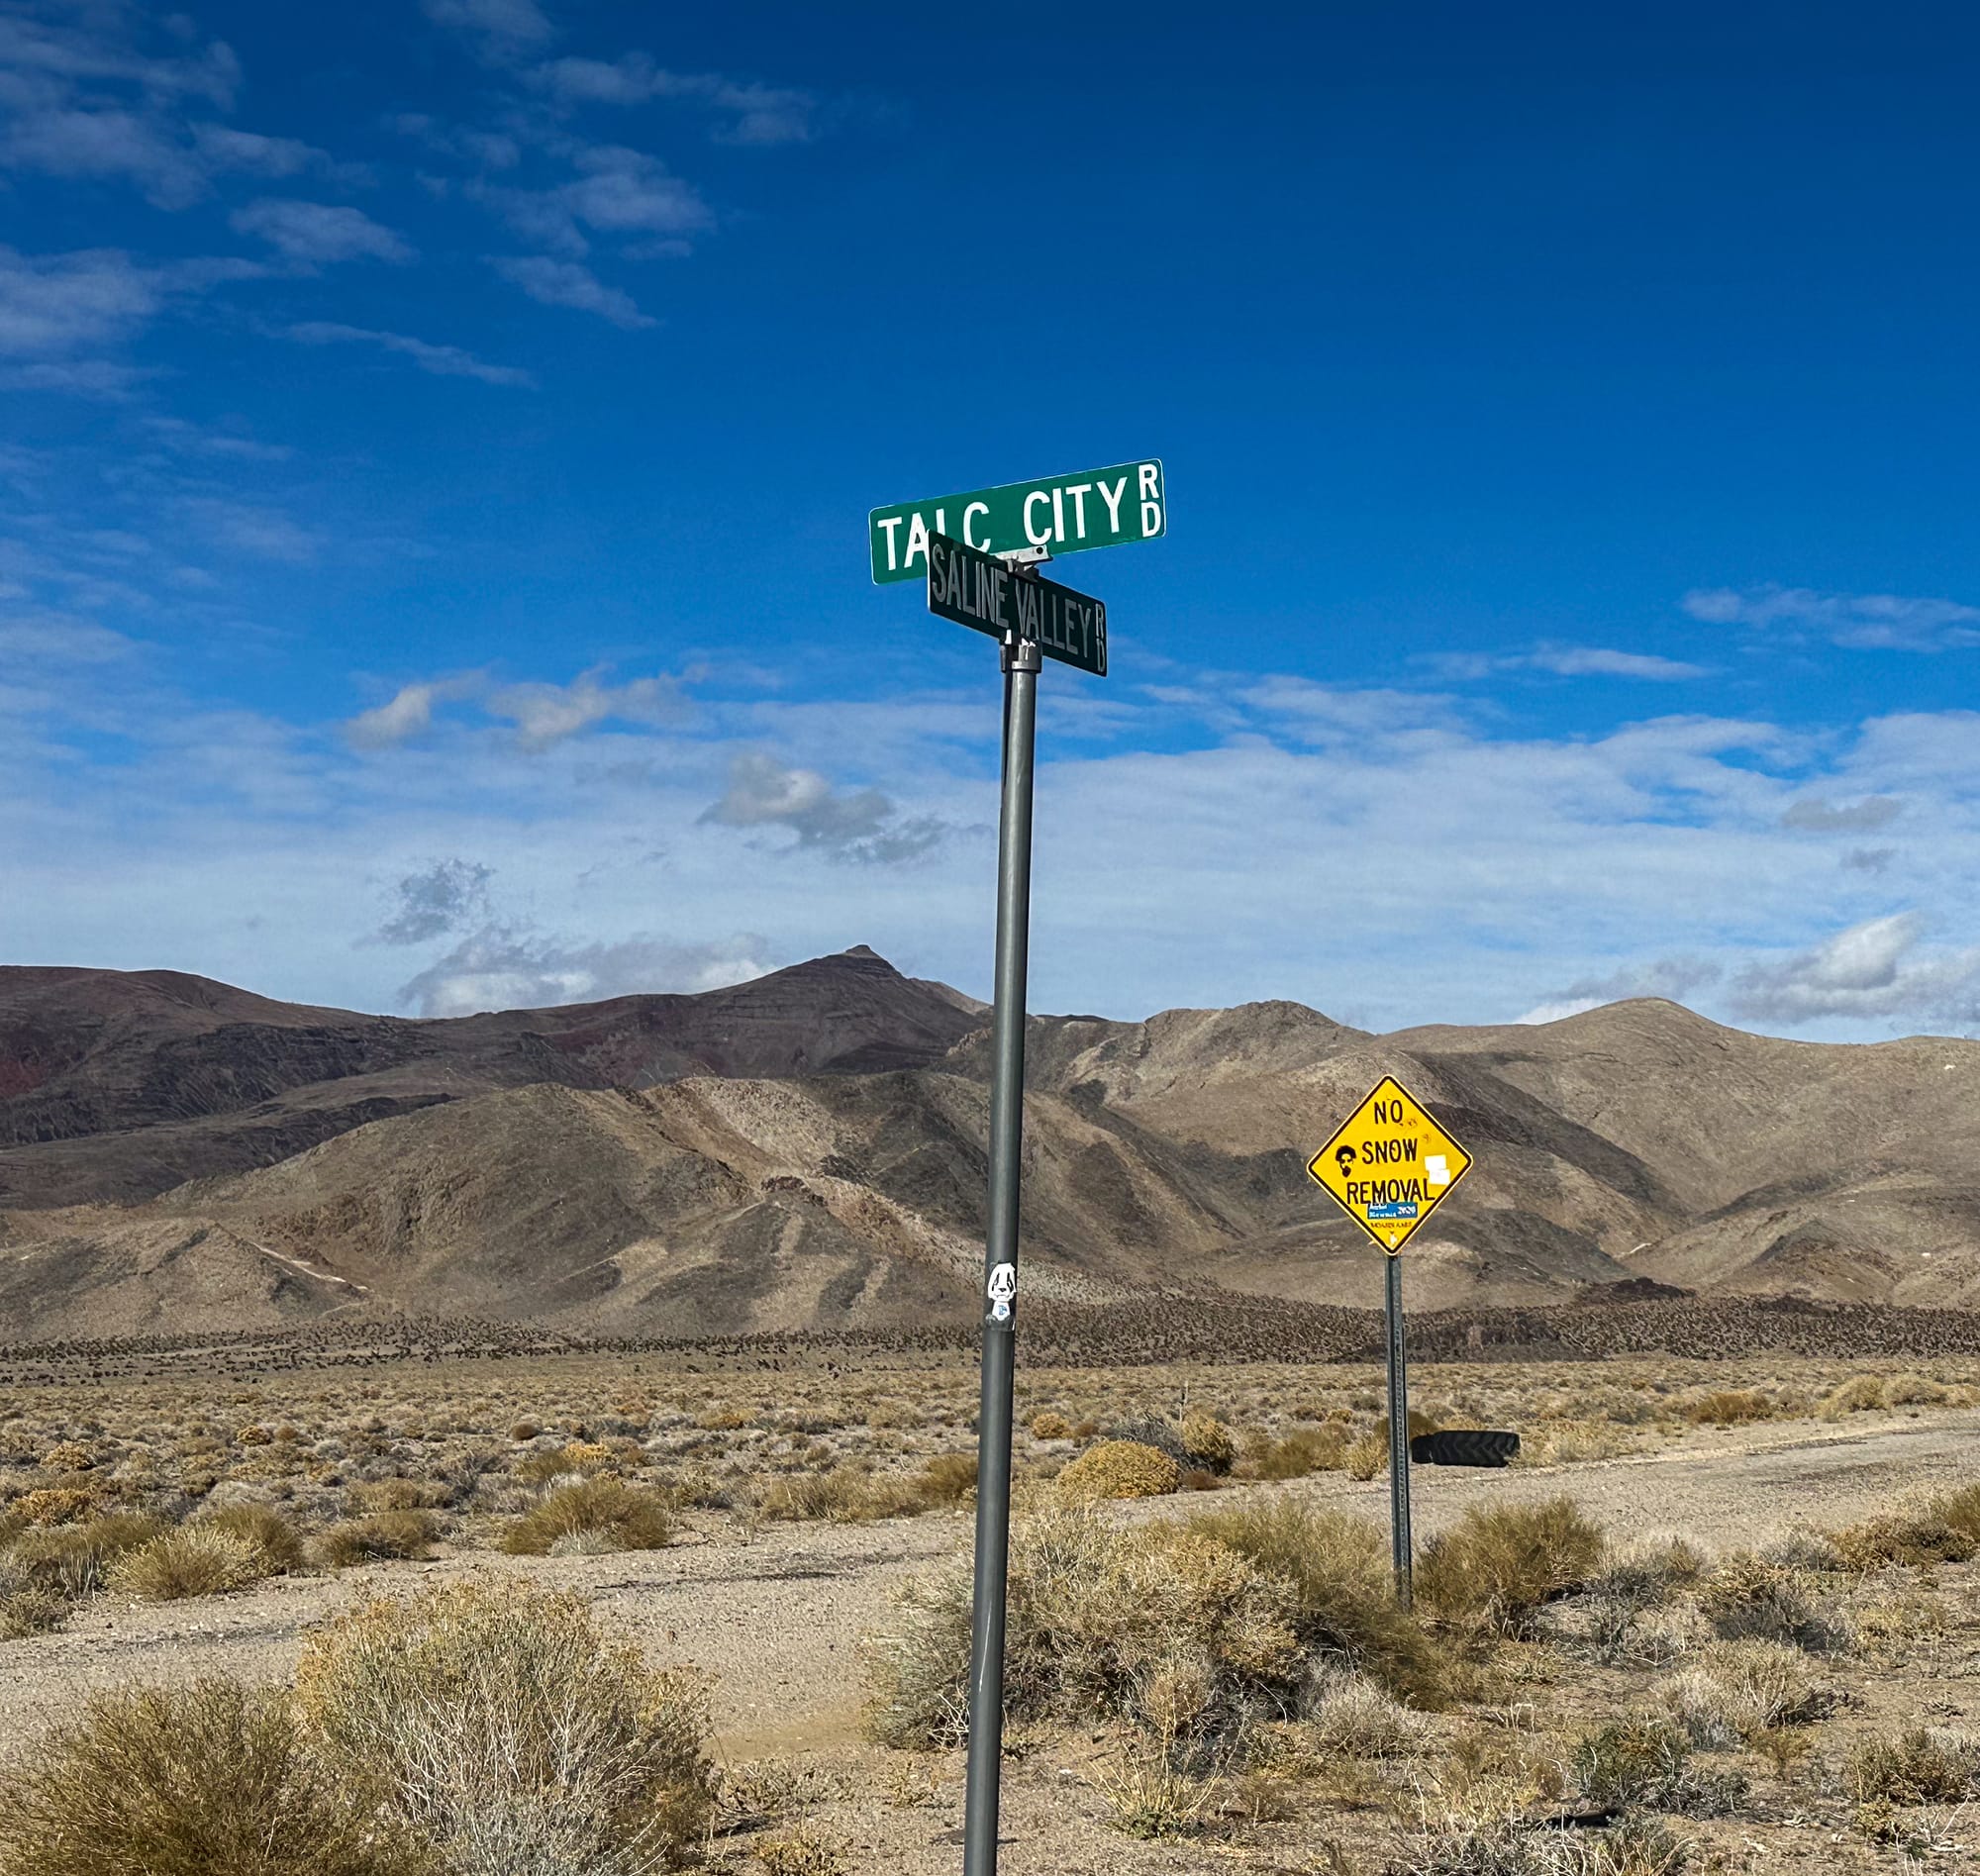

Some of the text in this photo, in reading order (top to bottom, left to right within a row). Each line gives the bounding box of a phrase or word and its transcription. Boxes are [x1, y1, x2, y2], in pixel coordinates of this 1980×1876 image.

[1023, 476, 1129, 545] CITY
[1138, 462, 1162, 538] RD
[932, 543, 1010, 630] SALINE
[1015, 580, 1092, 658] VALLEY
[1374, 1099, 1403, 1125] NO
[1361, 1138, 1418, 1164] SNOW
[1346, 1178, 1435, 1205] REMOVAL
